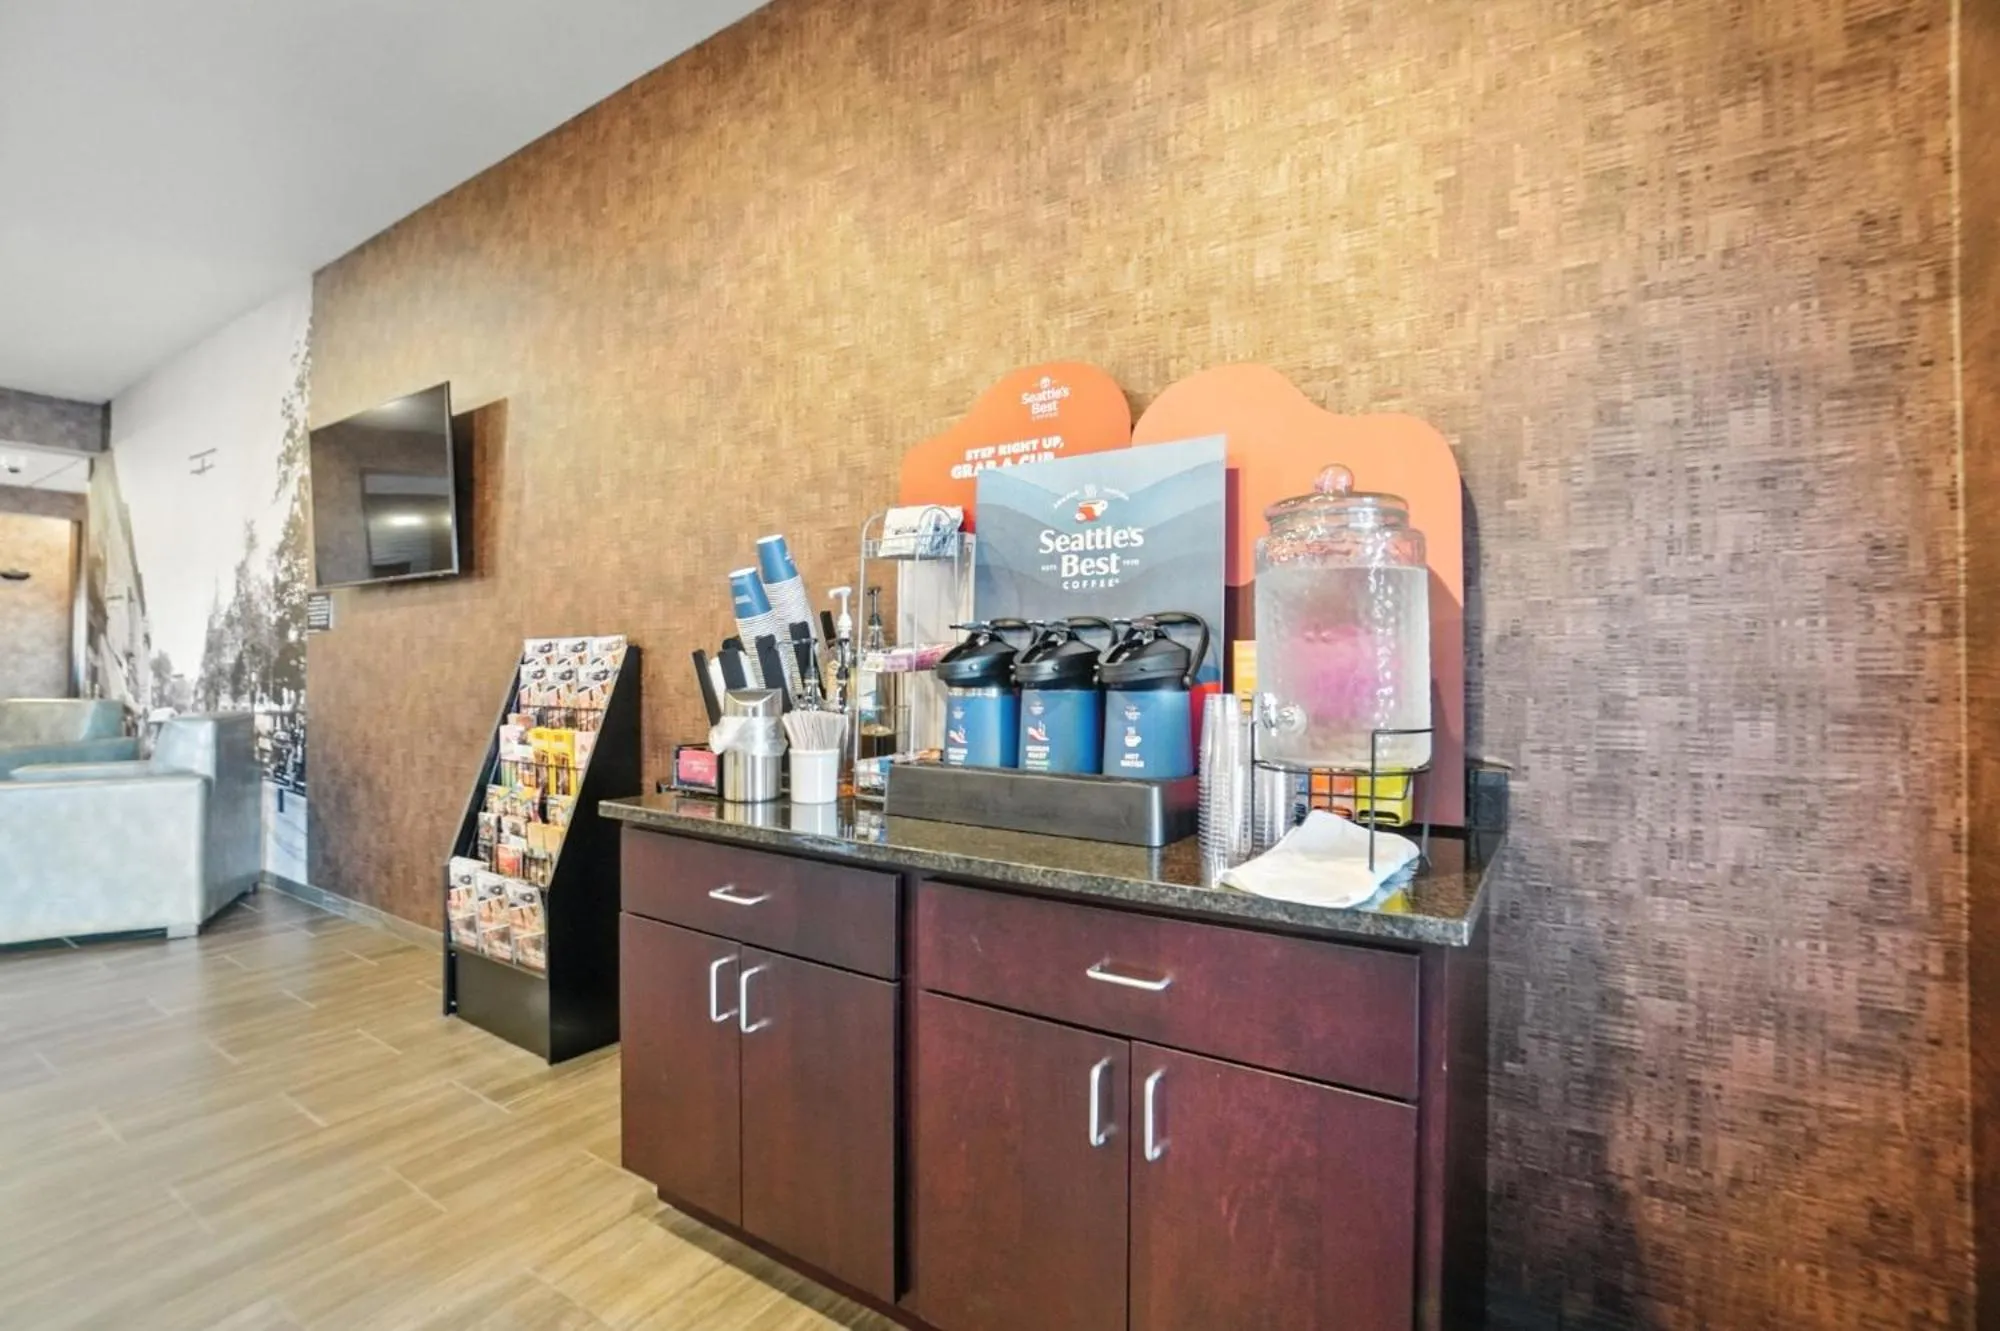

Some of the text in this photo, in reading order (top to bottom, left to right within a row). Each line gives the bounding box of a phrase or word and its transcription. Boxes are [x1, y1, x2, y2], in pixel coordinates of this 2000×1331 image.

[1021, 386, 1070, 405] Seattle's
[1031, 400, 1059, 415] Best
[966, 447, 996, 461] STEP
[998, 438, 1040, 456] RIGHT
[1039, 526, 1144, 554] Seattle's
[1060, 552, 1121, 578] Best
